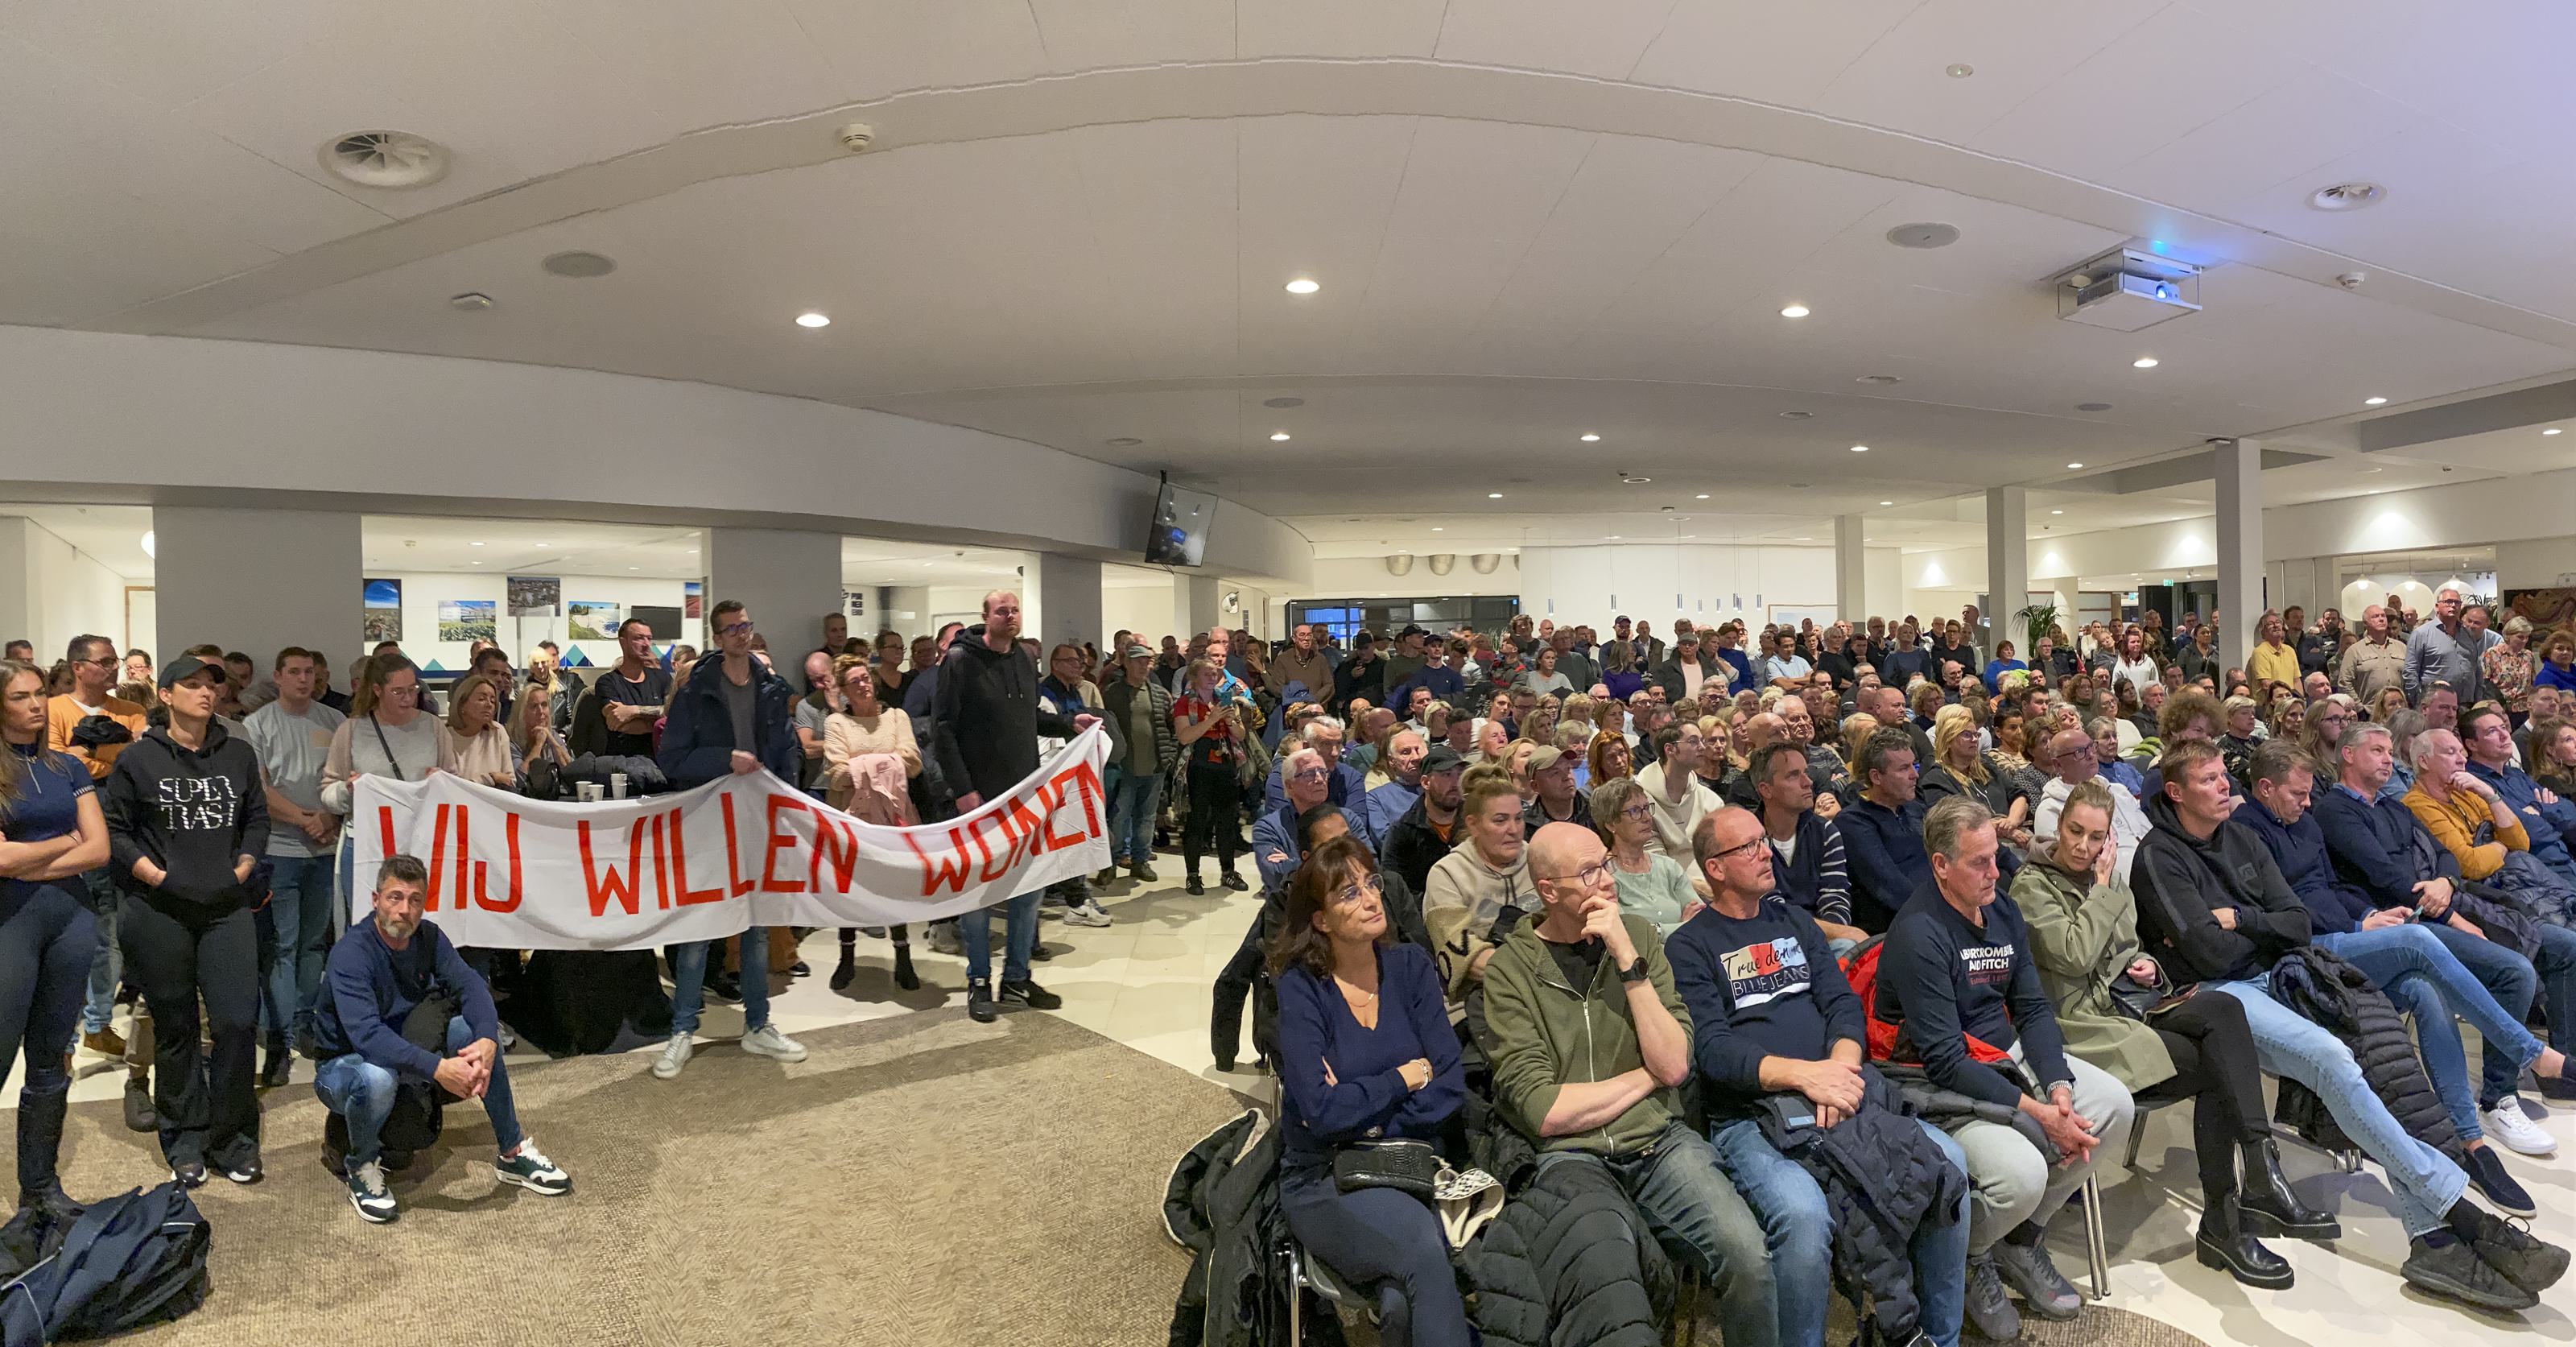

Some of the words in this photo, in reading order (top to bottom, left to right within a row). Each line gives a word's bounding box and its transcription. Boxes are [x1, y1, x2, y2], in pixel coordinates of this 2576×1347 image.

[159, 775, 238, 803] SUPER
[577, 791, 859, 917] WILLEN
[902, 759, 1105, 896] WONEN
[1723, 953, 1762, 980] True
[1981, 957, 2009, 970] FITCH
[1770, 965, 1810, 990] JEANS
